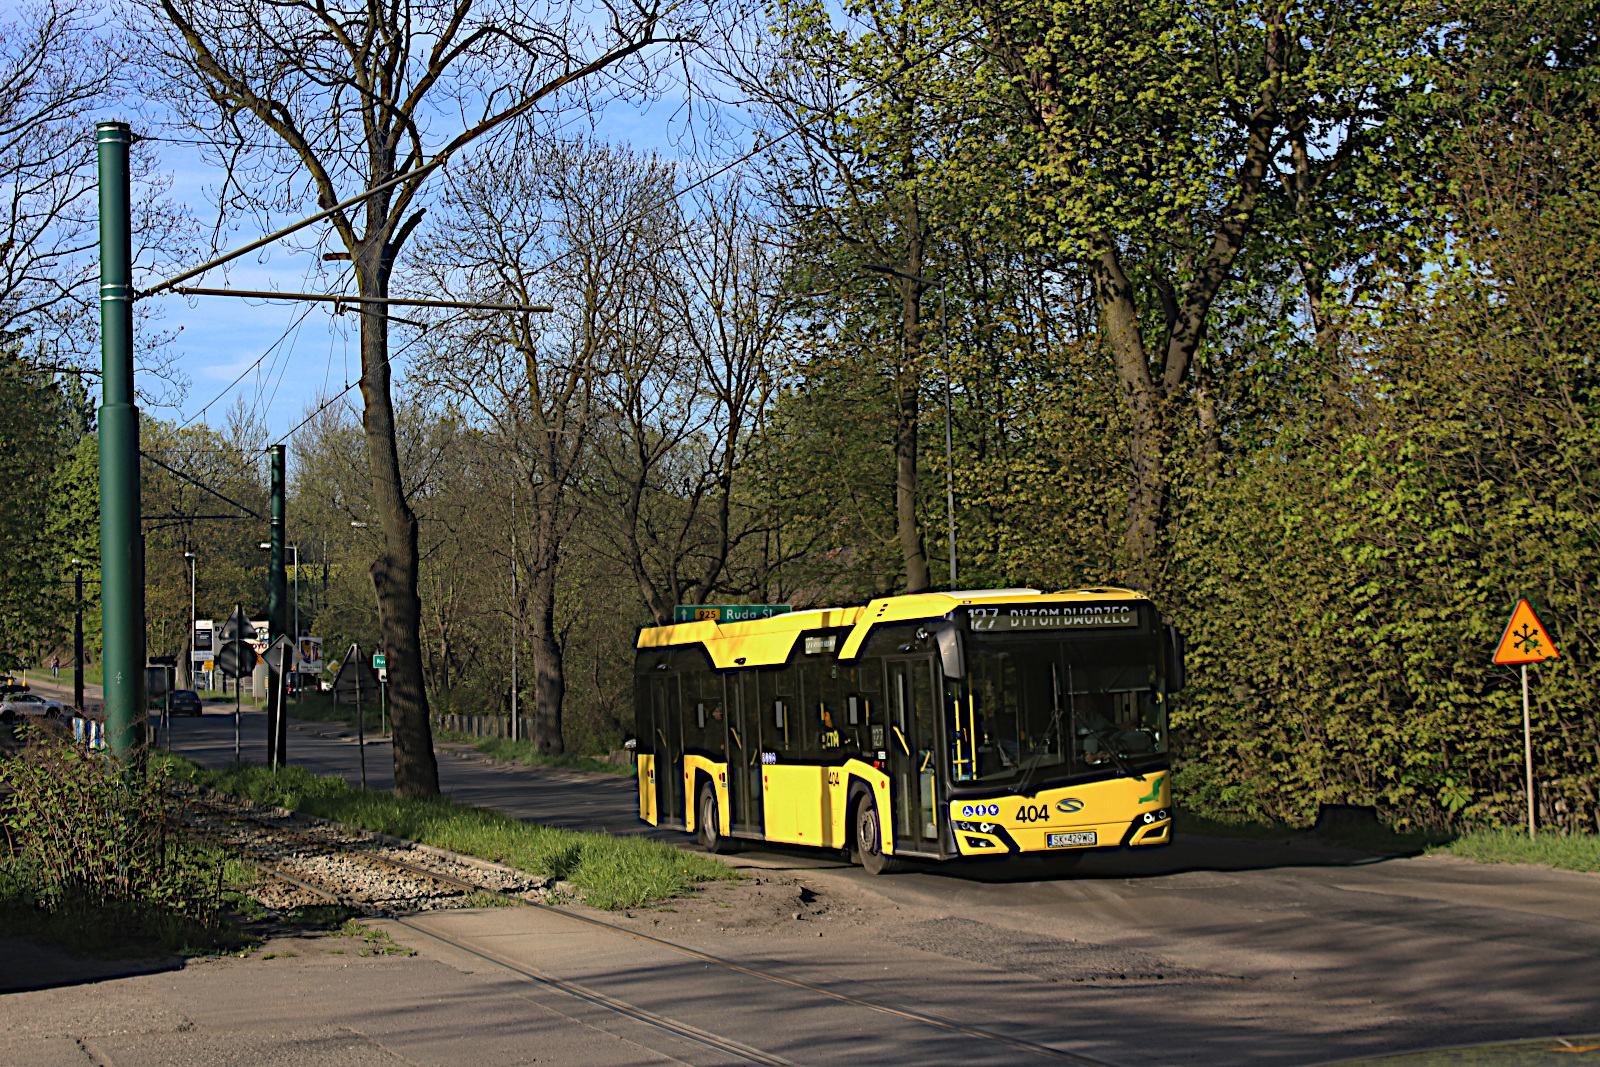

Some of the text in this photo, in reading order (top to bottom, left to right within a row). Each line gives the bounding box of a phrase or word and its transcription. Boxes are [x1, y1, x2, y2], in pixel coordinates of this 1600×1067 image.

[699, 611, 716, 619] 925
[726, 609, 757, 620] Ruda
[967, 606, 1130, 630] 127 BYTOM DWORZEC
[826, 731, 839, 747] ZTM
[828, 772, 839, 787] 404
[1016, 805, 1050, 823] 404
